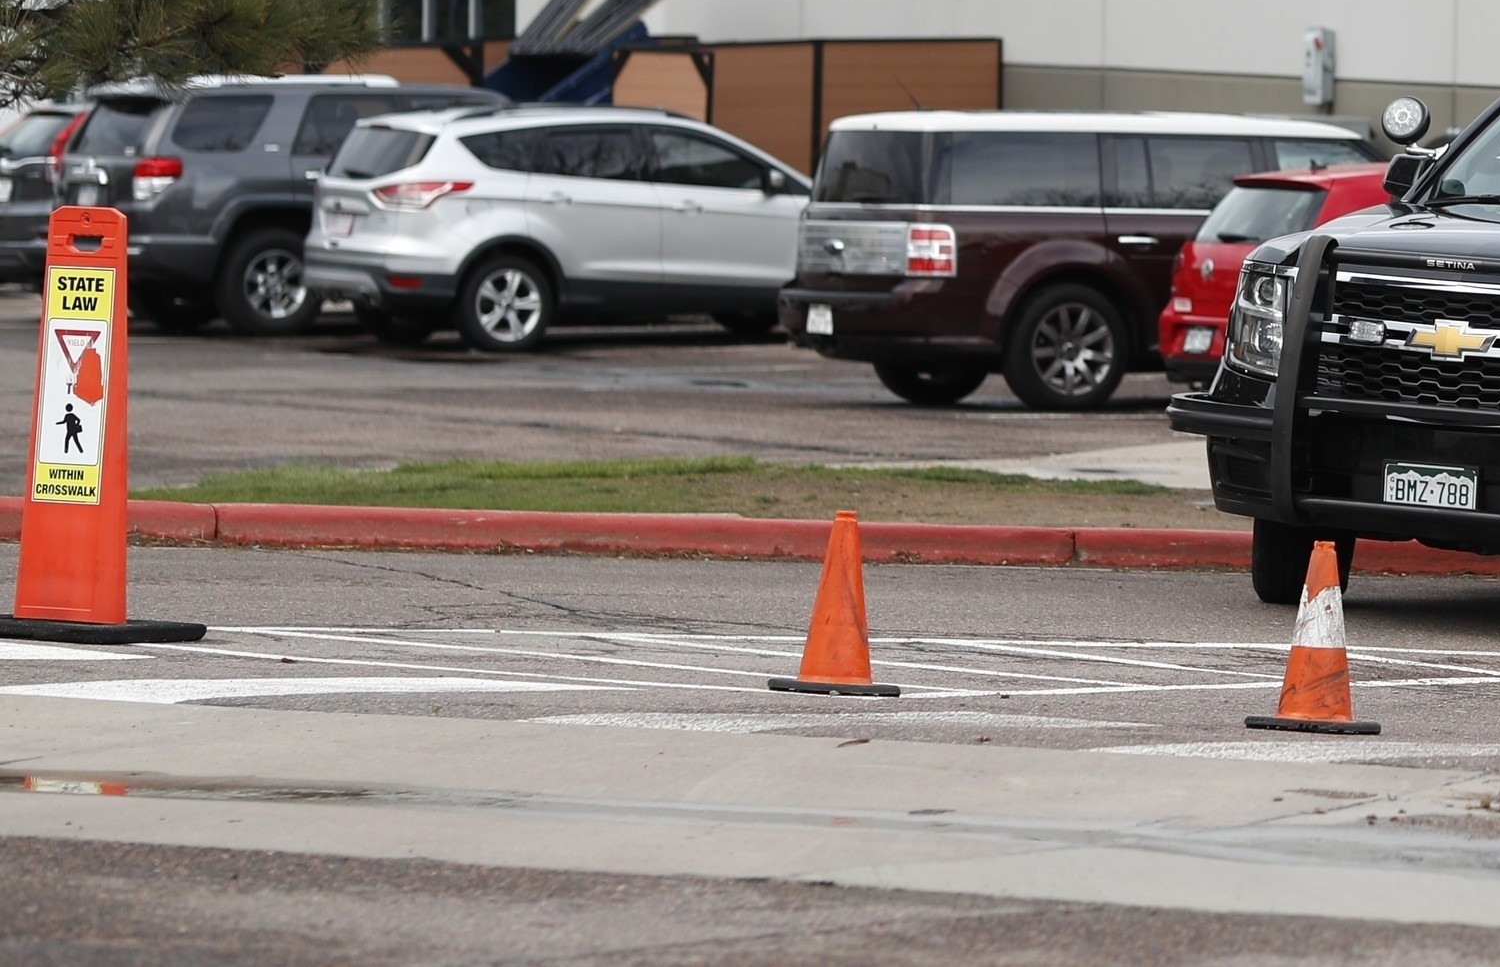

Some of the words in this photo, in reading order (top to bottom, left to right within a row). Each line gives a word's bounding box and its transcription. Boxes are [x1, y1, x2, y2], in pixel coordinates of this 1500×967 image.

[1426, 259, 1475, 270] SETINA
[57, 276, 105, 292] STATE
[62, 296, 98, 311] LAW
[67, 339, 85, 347] YIELD
[49, 468, 84, 480] WITHIN
[36, 483, 96, 497] CROSSWALK
